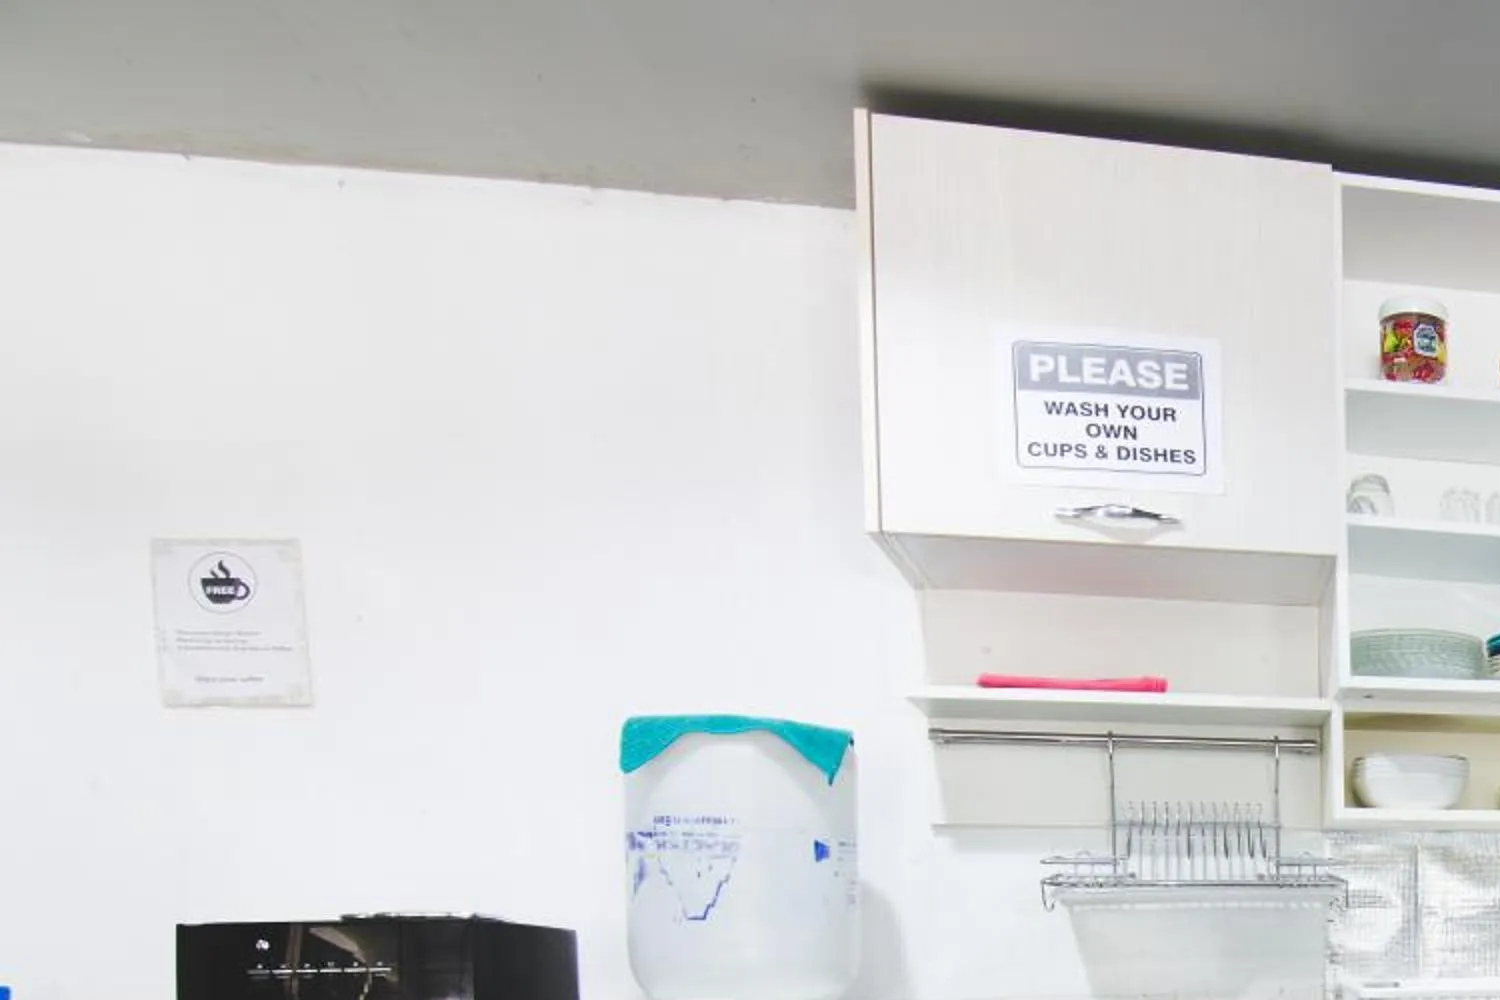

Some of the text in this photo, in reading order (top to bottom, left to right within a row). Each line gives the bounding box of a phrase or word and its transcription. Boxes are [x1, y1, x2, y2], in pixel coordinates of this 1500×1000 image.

[1028, 353, 1190, 391] PLEASE
[1044, 400, 1177, 422] WASH YOUR
[1085, 423, 1138, 440] OWN
[1027, 442, 1196, 464] CUPS & DISHES
[205, 585, 235, 595] FREE
